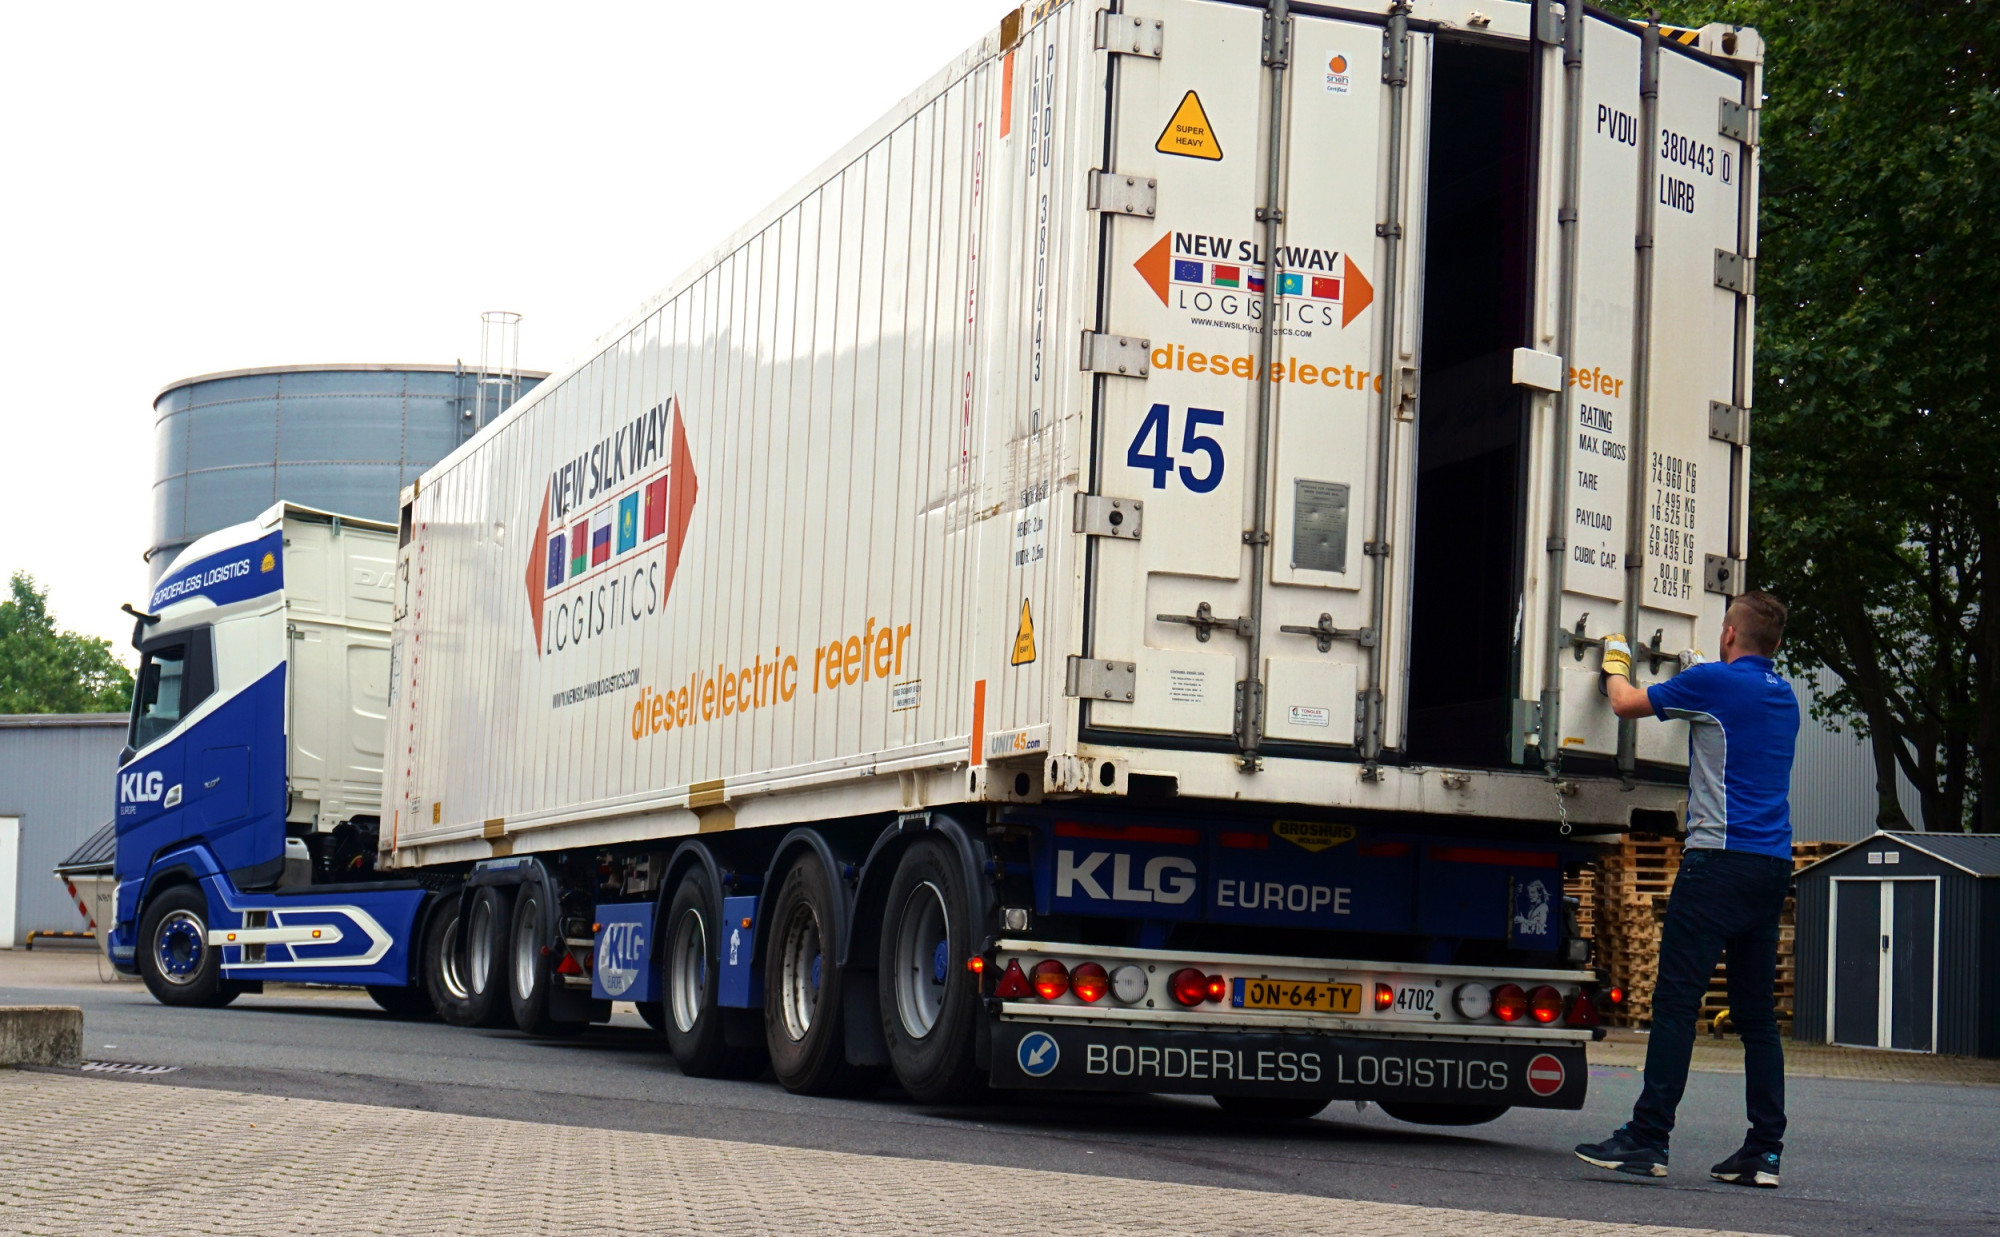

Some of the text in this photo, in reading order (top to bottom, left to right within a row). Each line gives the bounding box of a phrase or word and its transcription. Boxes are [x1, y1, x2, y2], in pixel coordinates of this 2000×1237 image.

[1176, 124, 1204, 135] SUPER
[1176, 136, 1204, 147] HEAVY
[1597, 103, 1730, 182] PVDU 380443 0
[1659, 173, 1695, 214] LNRB
[1174, 232, 1339, 272] NEW SLKWAY
[1568, 366, 1624, 399] eefer
[1580, 403, 1613, 431] RATING
[1127, 402, 1225, 494] 45
[1579, 433, 1627, 461] MAX. GROSS
[1652, 451, 1697, 478] 34.000 KG
[550, 451, 589, 522] NEW
[1577, 470, 1599, 491] TARE
[1652, 468, 1696, 494] 74.960 LB
[1657, 489, 1696, 514] 7.495 KG
[1576, 508, 1612, 532] PAYLOAD
[1651, 504, 1695, 529] 16.525 LB
[1650, 524, 1695, 549] 26.505 KG
[1574, 545, 1617, 570] CUBIC CAP.
[1649, 540, 1694, 565] 58.435 LB
[153, 558, 250, 606] BORDERLESS LOGISTICS
[1660, 562, 1678, 581] 80.0
[1653, 577, 1678, 597] 2.825
[546, 561, 658, 656] LOGISTICS
[632, 616, 912, 741] diesel/electric reefer
[120, 770, 164, 803] KLG
[120, 805, 137, 816] EUROPE
[1279, 822, 1352, 839] BROSHUIS
[1056, 850, 1352, 915] KLG EUROPE
[608, 925, 645, 970] KLG
[1251, 983, 1353, 1009] ON-64-TY
[1397, 988, 1435, 1011] 4702
[1086, 1043, 1509, 1091] BORDERLESS LOGISTICS
